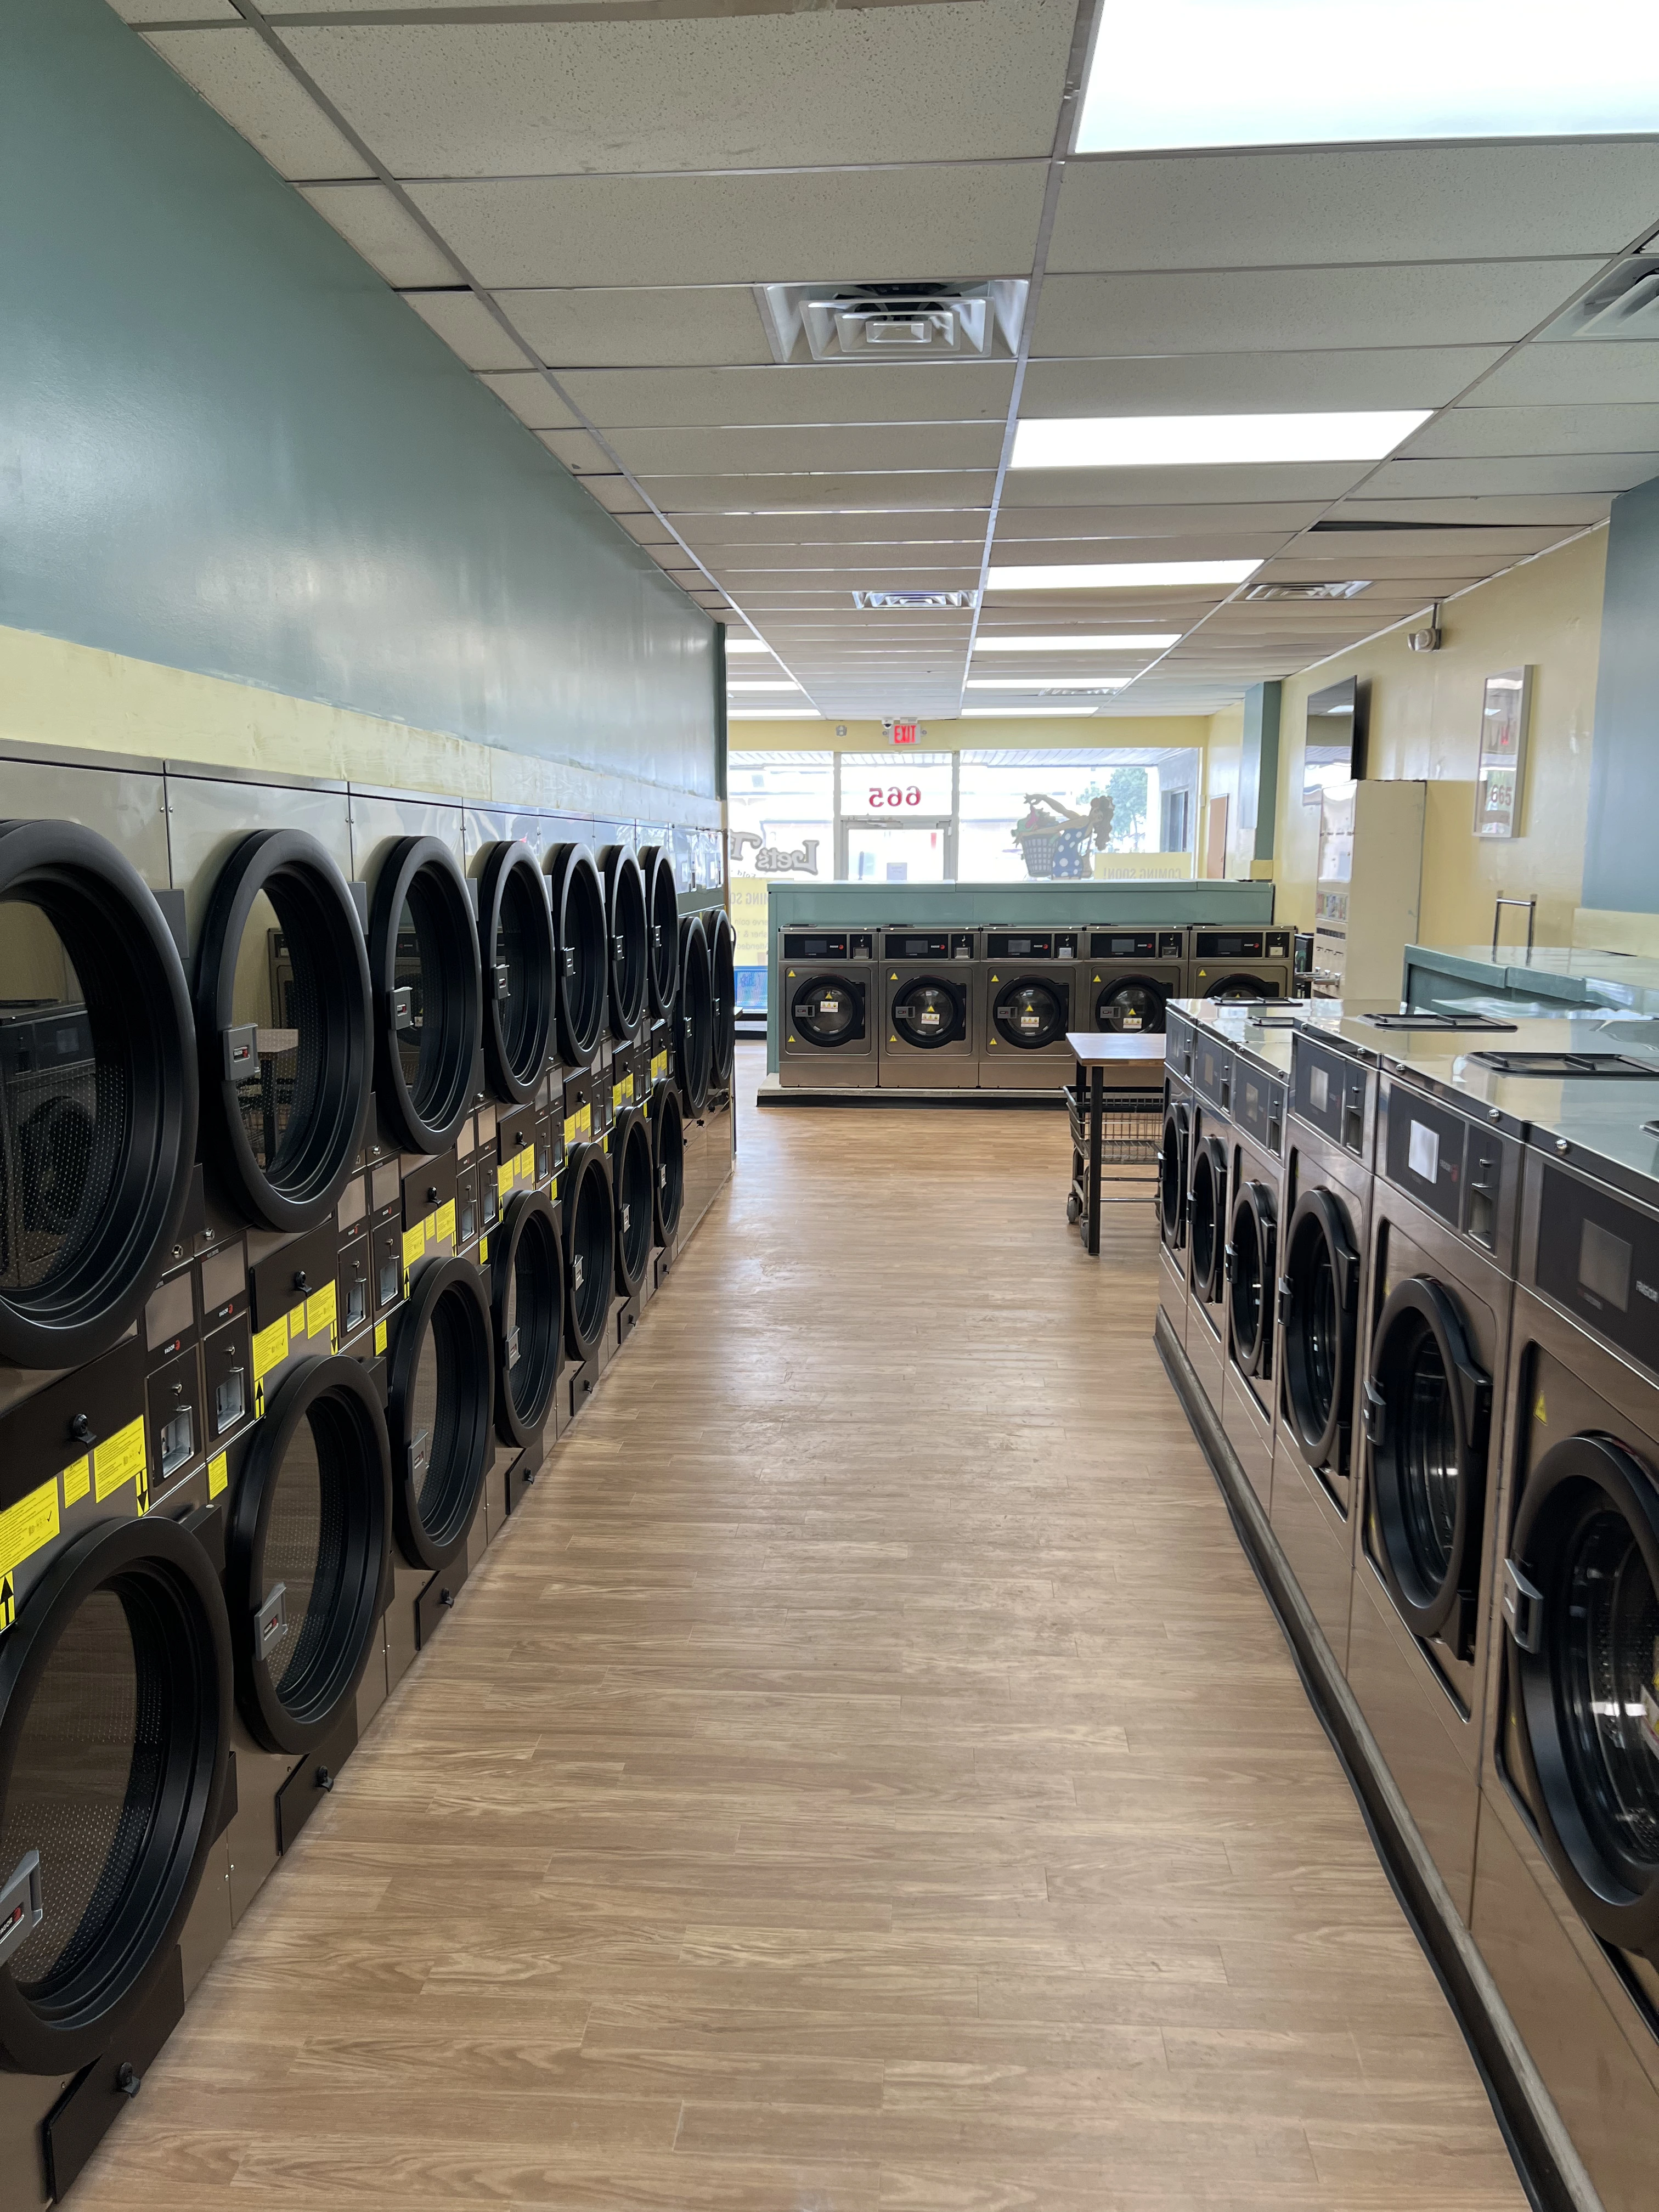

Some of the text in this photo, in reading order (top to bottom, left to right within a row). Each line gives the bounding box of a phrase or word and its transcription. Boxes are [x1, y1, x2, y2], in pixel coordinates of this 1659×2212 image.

[894, 725, 916, 743] EXIT
[1491, 784, 1513, 806] 665
[0, 1917, 13, 1935] AGOR
